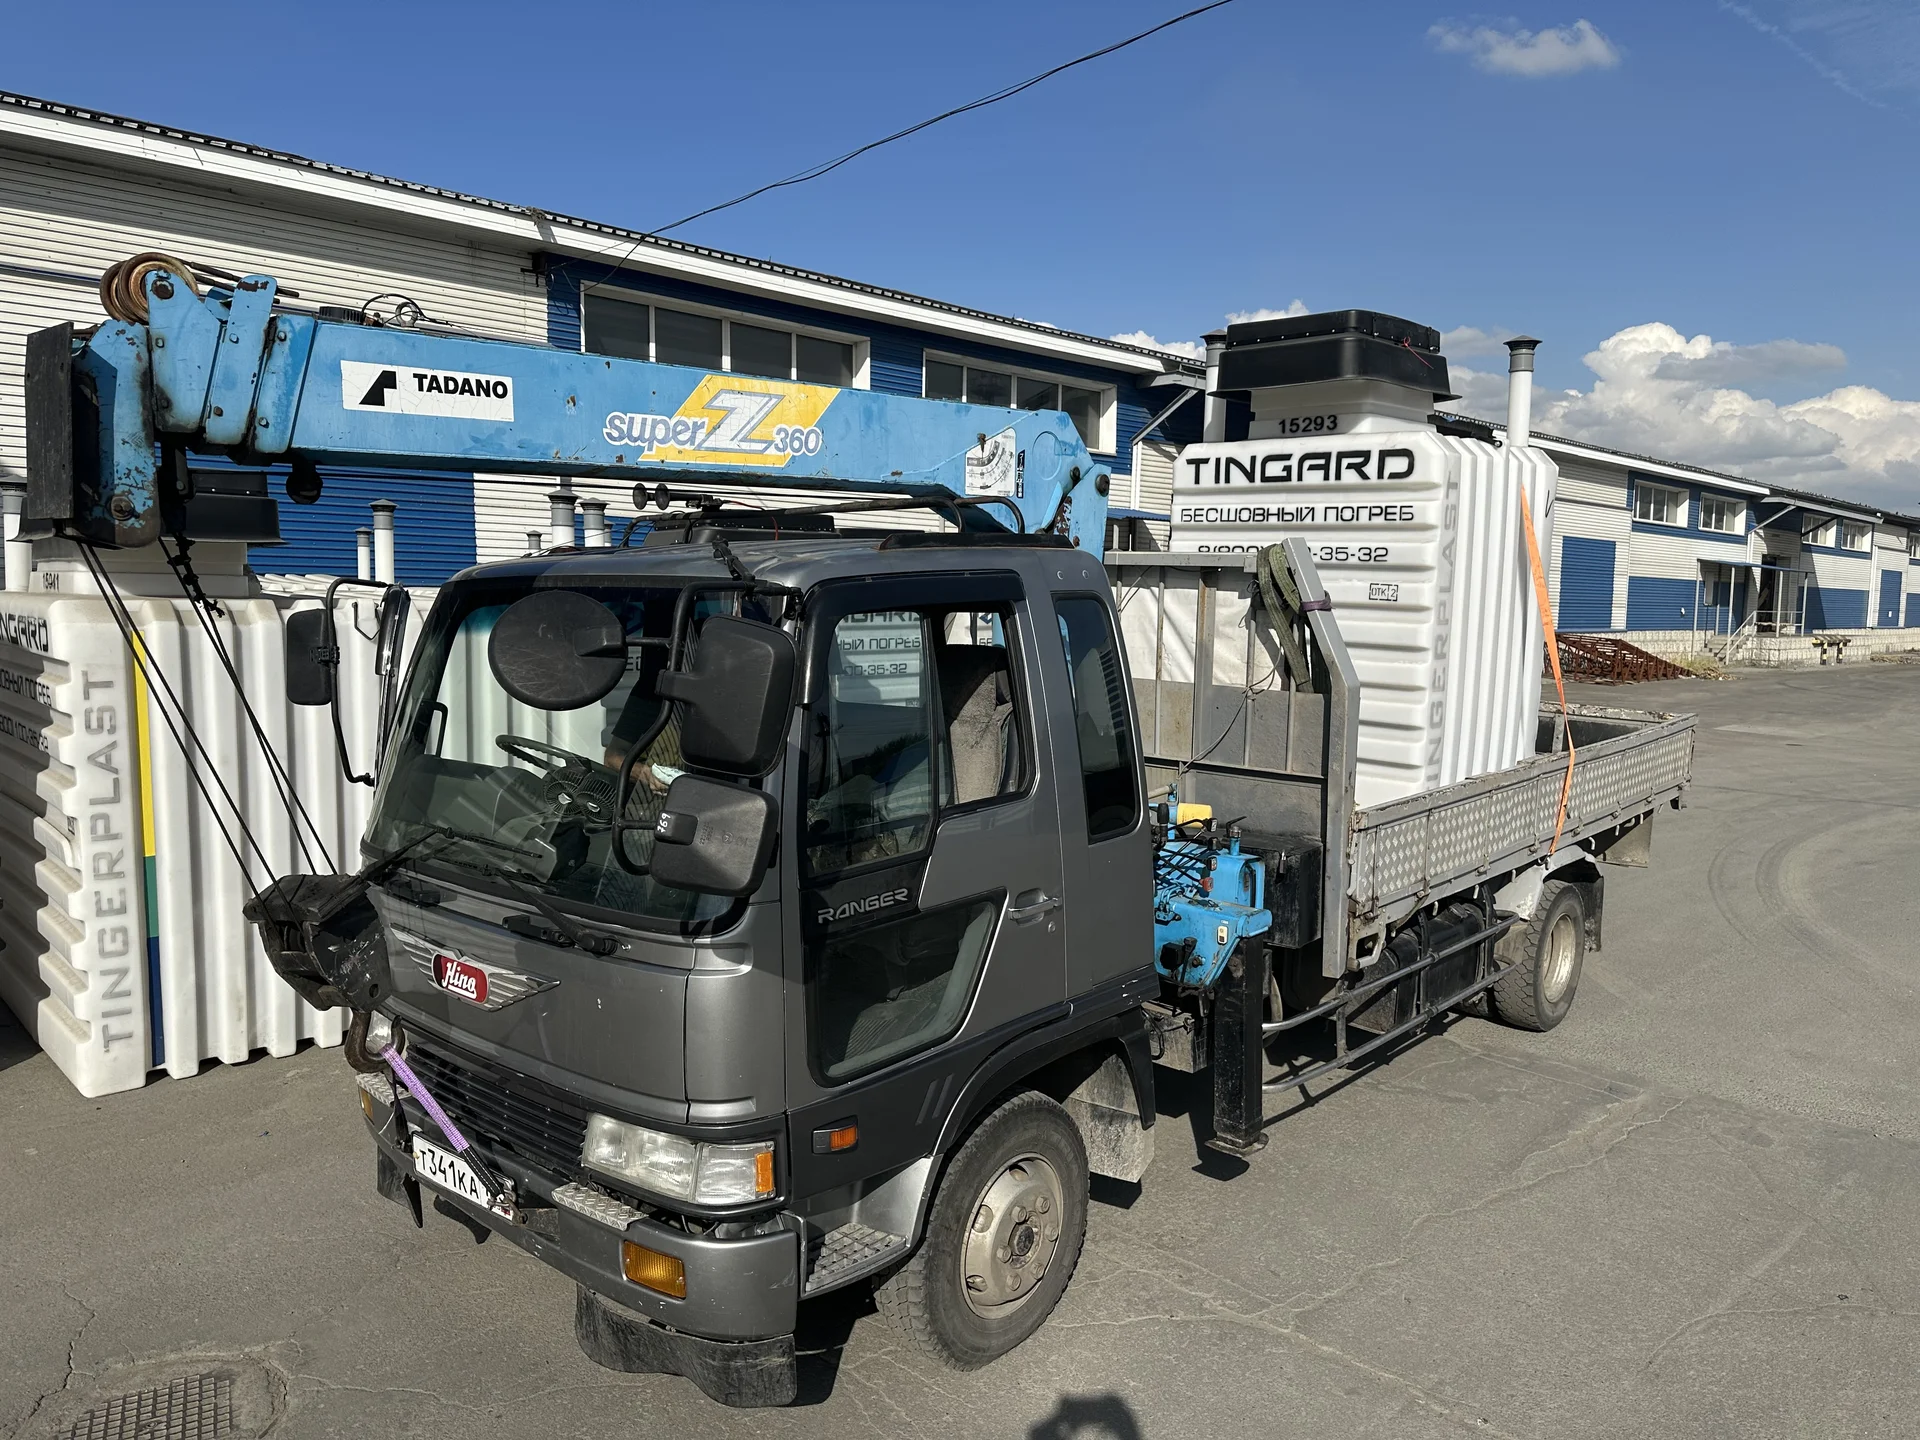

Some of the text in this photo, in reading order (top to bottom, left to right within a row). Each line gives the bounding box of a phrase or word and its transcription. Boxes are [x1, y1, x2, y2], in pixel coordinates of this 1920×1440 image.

[412, 373, 509, 399] TADANO
[604, 412, 708, 453] super
[773, 425, 823, 455] 360
[1278, 414, 1338, 435] 15293
[1186, 447, 1416, 485] TINGARD
[1180, 505, 1415, 523] БЕСШОВНЫЙ ПОГРЕБ
[1390, 588, 1397, 598] 2
[0, 610, 49, 653] NGARD
[869, 637, 921, 650] ПОГРЕБ
[1426, 470, 1459, 788] INGERPLAST
[82, 670, 134, 1053] TINGERPLAST
[817, 887, 909, 924] RANGER
[441, 961, 477, 995] Hino
